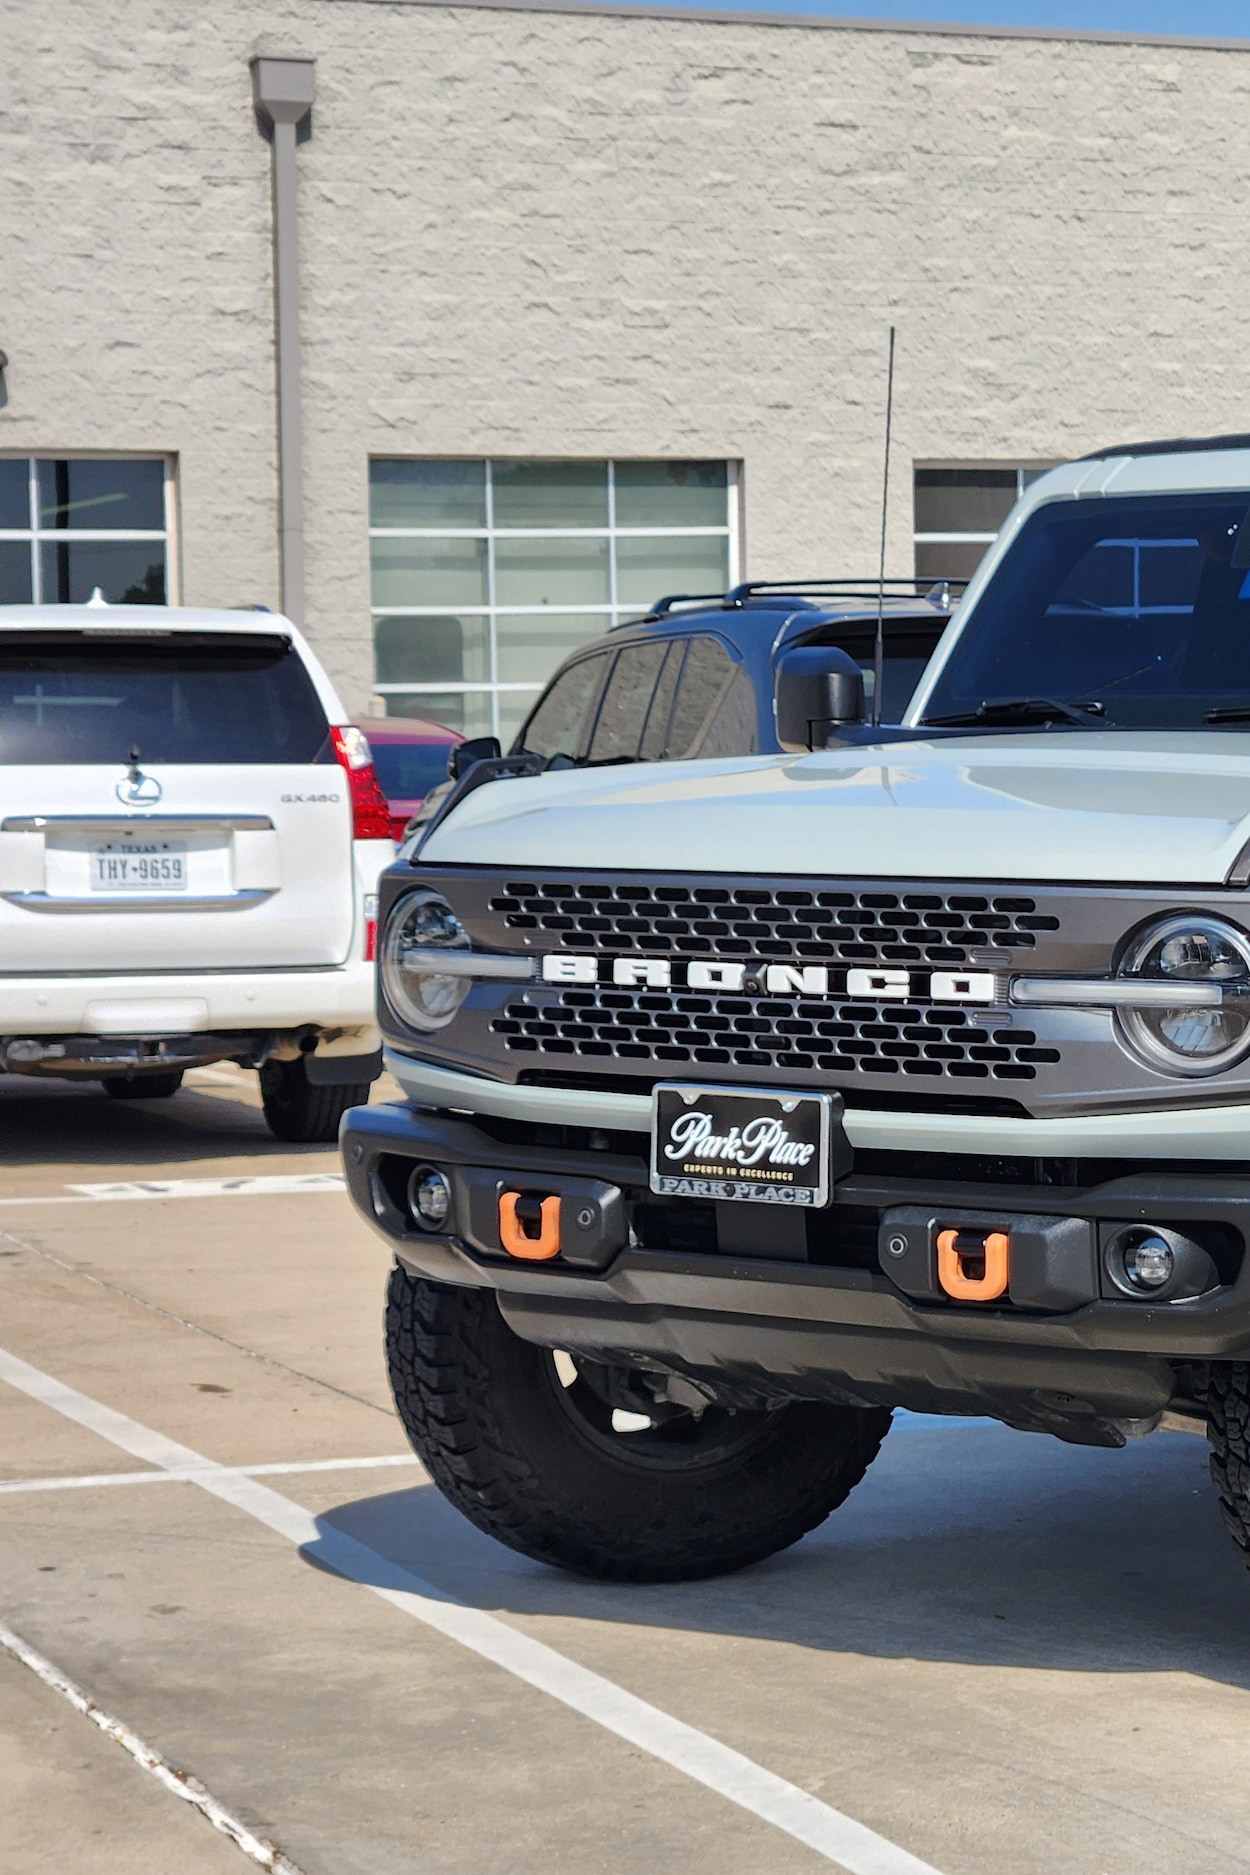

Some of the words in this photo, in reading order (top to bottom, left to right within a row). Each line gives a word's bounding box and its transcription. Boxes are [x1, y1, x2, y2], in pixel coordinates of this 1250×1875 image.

[121, 844, 157, 854] TEXAS
[542, 953, 996, 1002] BRONCO
[664, 1111, 742, 1161] Park
[735, 1116, 816, 1167] Place
[683, 1163, 724, 1176] EXPERTS
[726, 1166, 738, 1176] IN
[739, 1168, 794, 1182] EXCELLENCE
[661, 1178, 729, 1197] PARK
[734, 1183, 812, 1204] PLACE
